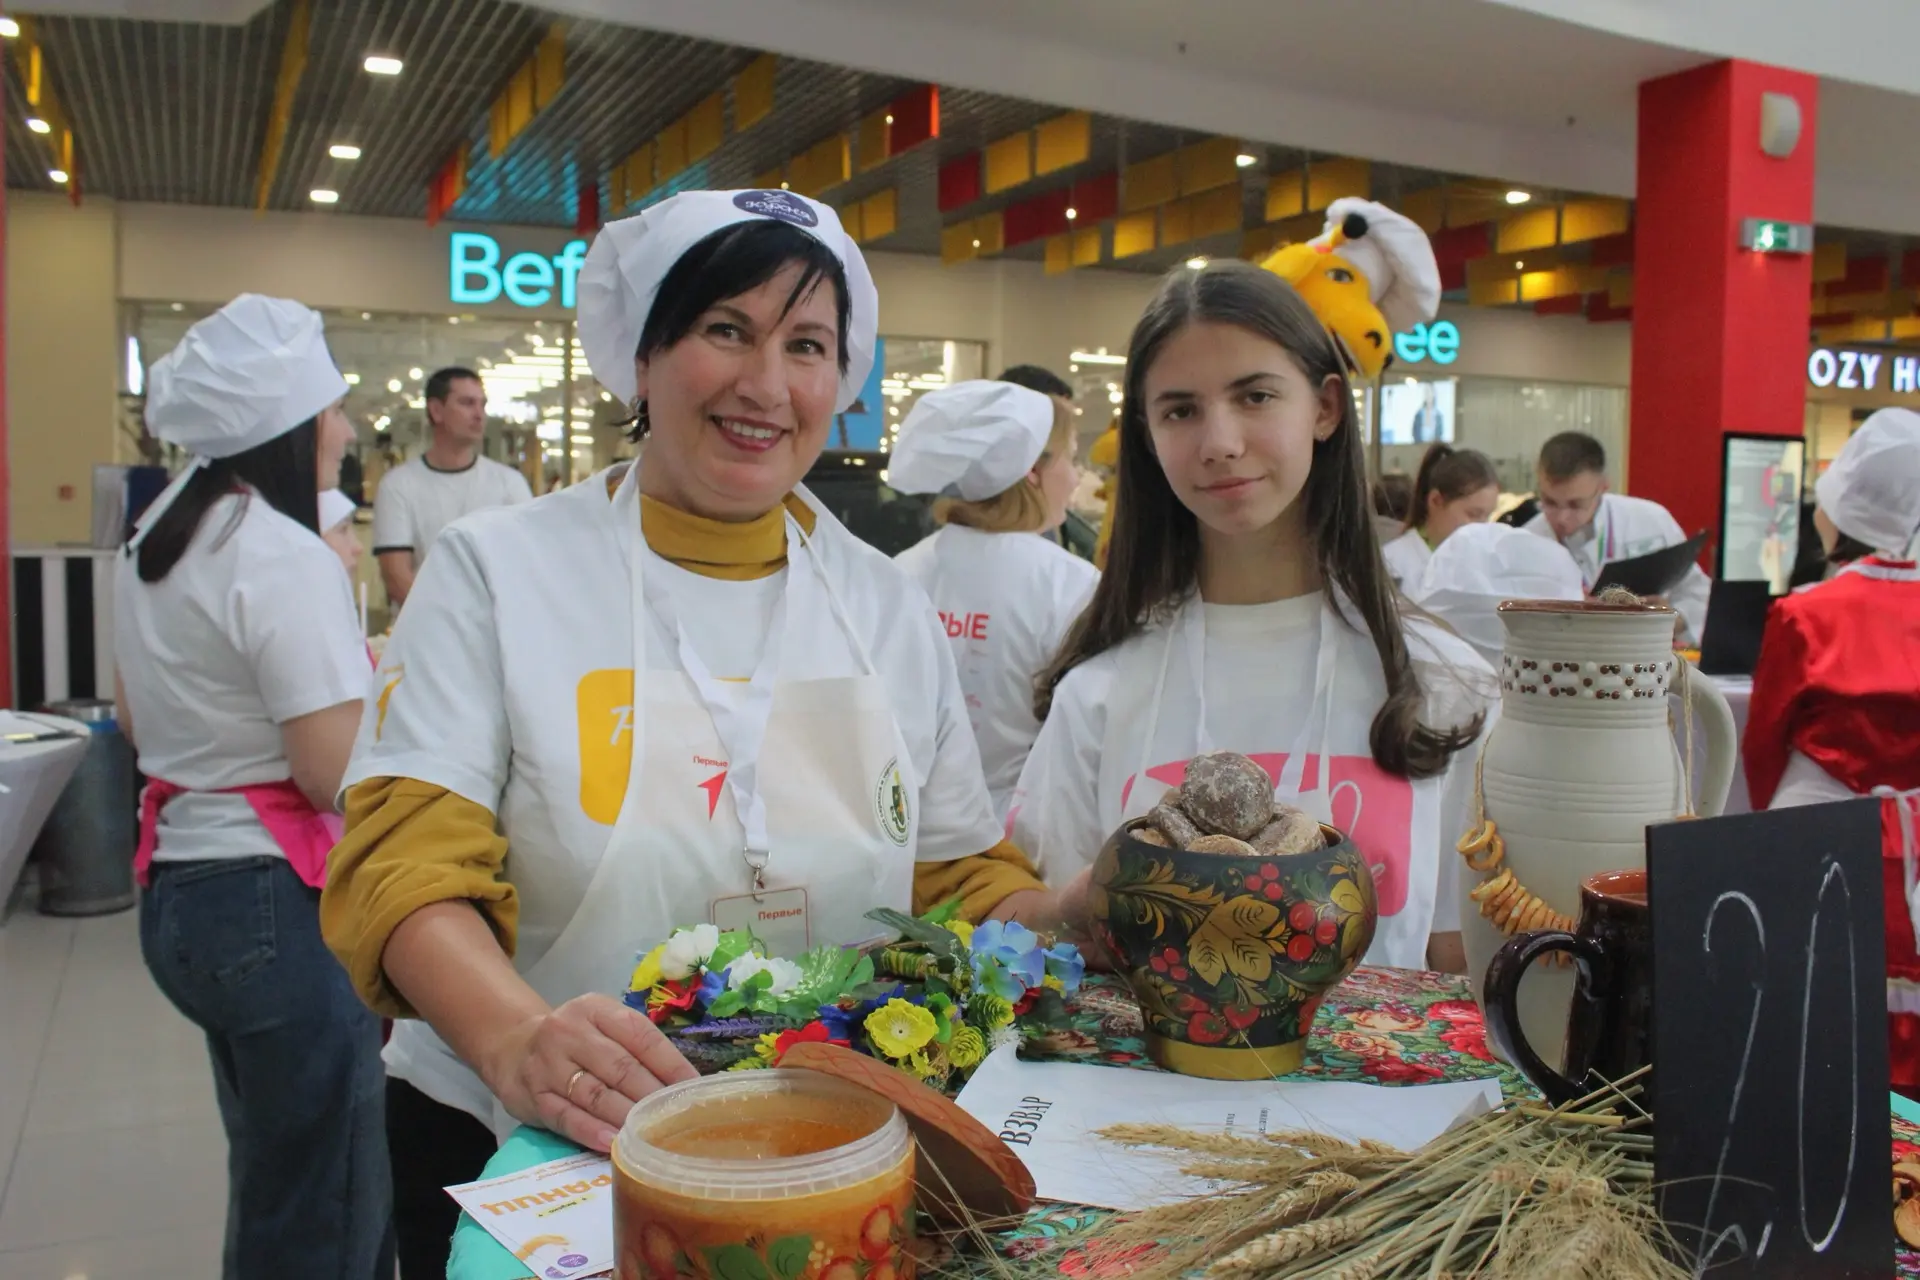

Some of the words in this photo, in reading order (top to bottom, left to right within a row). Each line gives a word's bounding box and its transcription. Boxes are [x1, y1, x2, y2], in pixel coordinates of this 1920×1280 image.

[451, 231, 587, 308] Bef
[1808, 348, 1882, 390] OZY
[1893, 356, 1920, 392] H
[692, 754, 729, 768] Первые
[757, 907, 803, 921] Первые
[999, 1096, 1053, 1147] ВЗВАР
